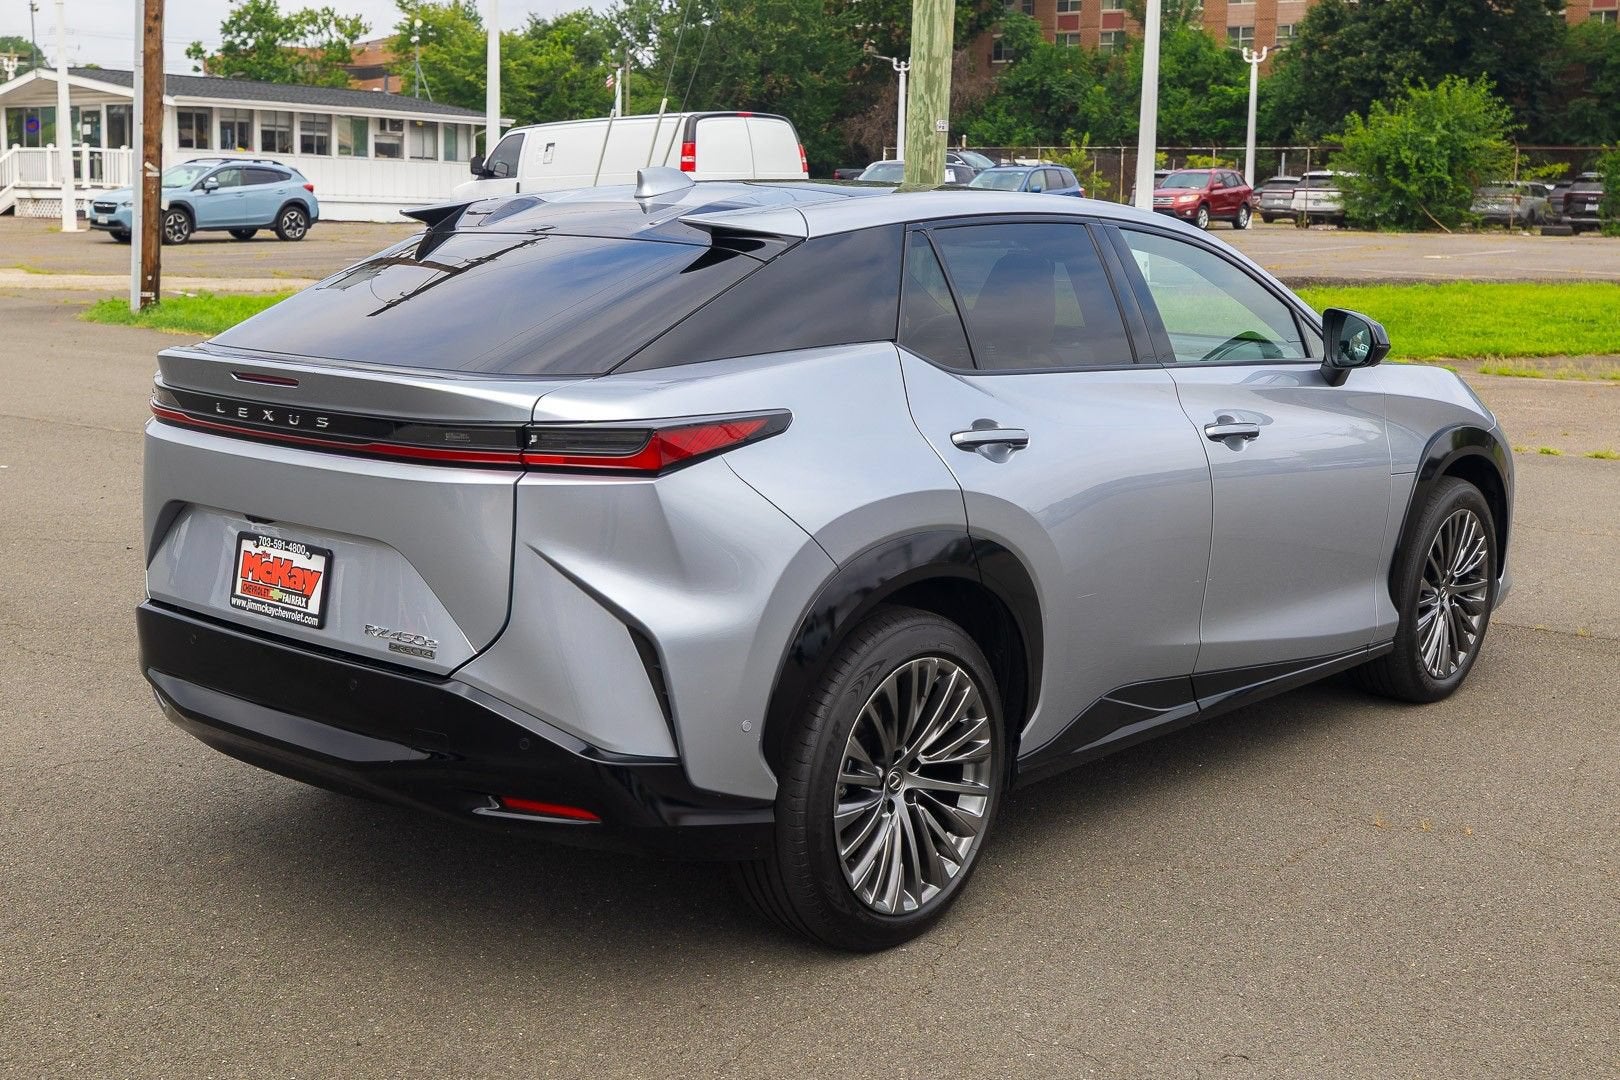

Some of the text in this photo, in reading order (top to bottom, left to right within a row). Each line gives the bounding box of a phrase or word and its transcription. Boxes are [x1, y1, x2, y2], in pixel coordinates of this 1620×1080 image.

[216, 402, 329, 428] LEXUS
[258, 536, 306, 554] 703-591-4800
[240, 550, 322, 598] McKay
[243, 583, 270, 597] CHEVROLET
[282, 593, 307, 607] FAIRFAX
[232, 597, 318, 626] www.jimmckaychevrolet.com
